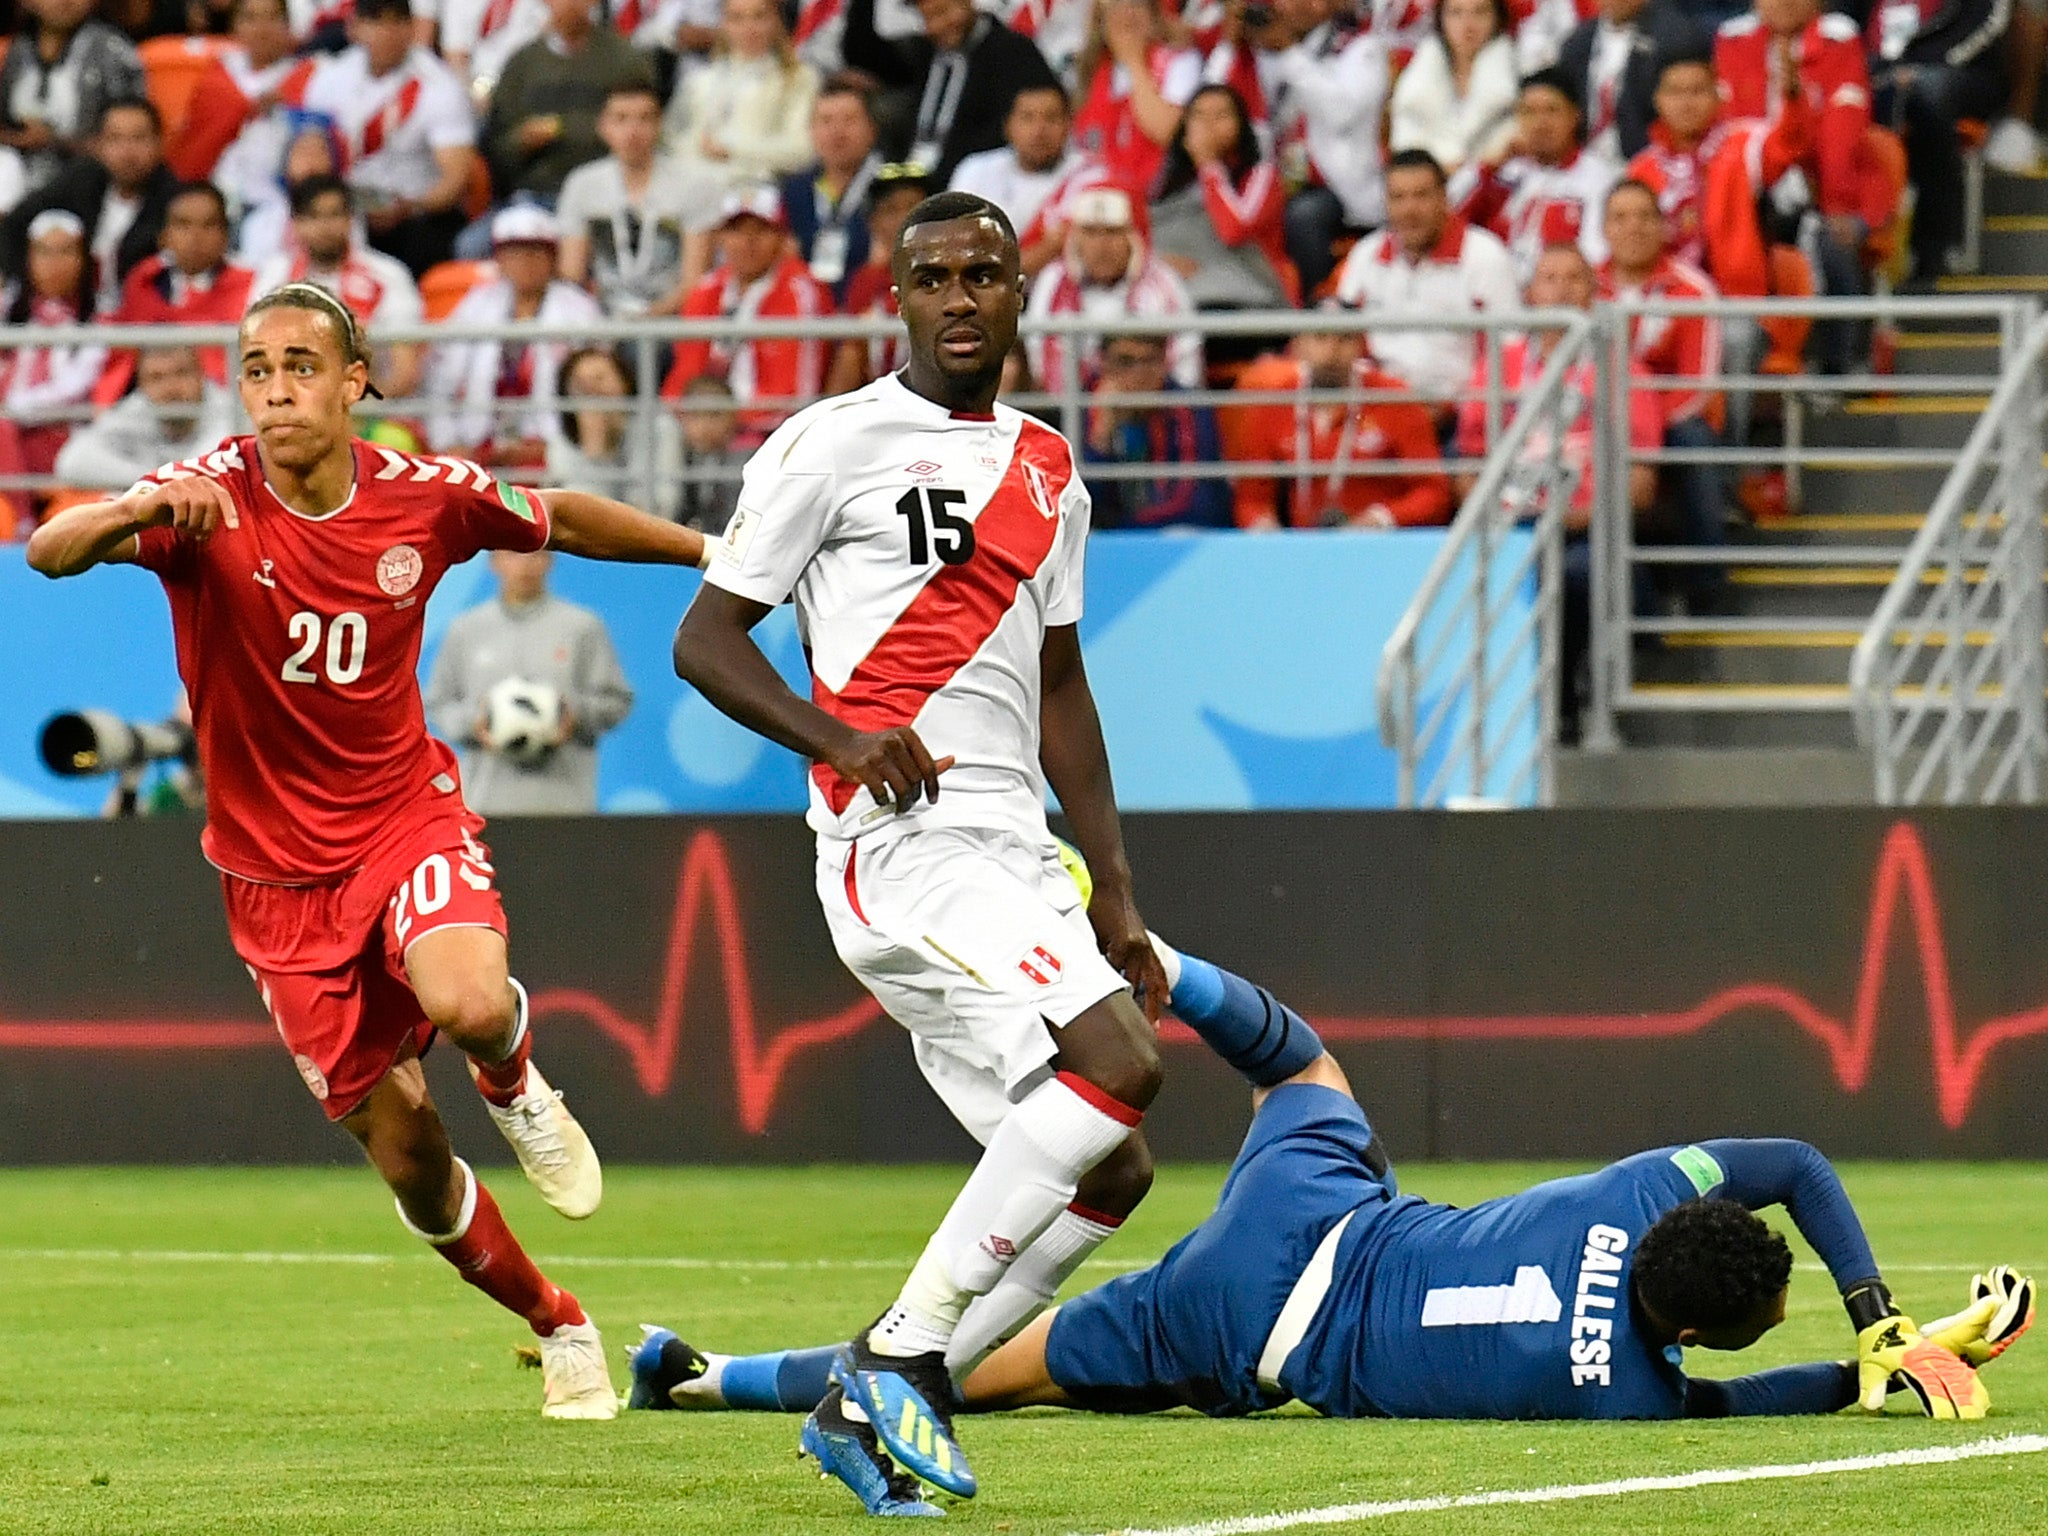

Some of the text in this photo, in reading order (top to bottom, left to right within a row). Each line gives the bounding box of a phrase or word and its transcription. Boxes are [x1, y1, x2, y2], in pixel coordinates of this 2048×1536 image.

[895, 486, 975, 565] 15
[281, 611, 367, 684] 20
[389, 854, 451, 947] 20
[1421, 1265, 1563, 1327] 1
[1570, 1223, 1629, 1387] GALLESE
